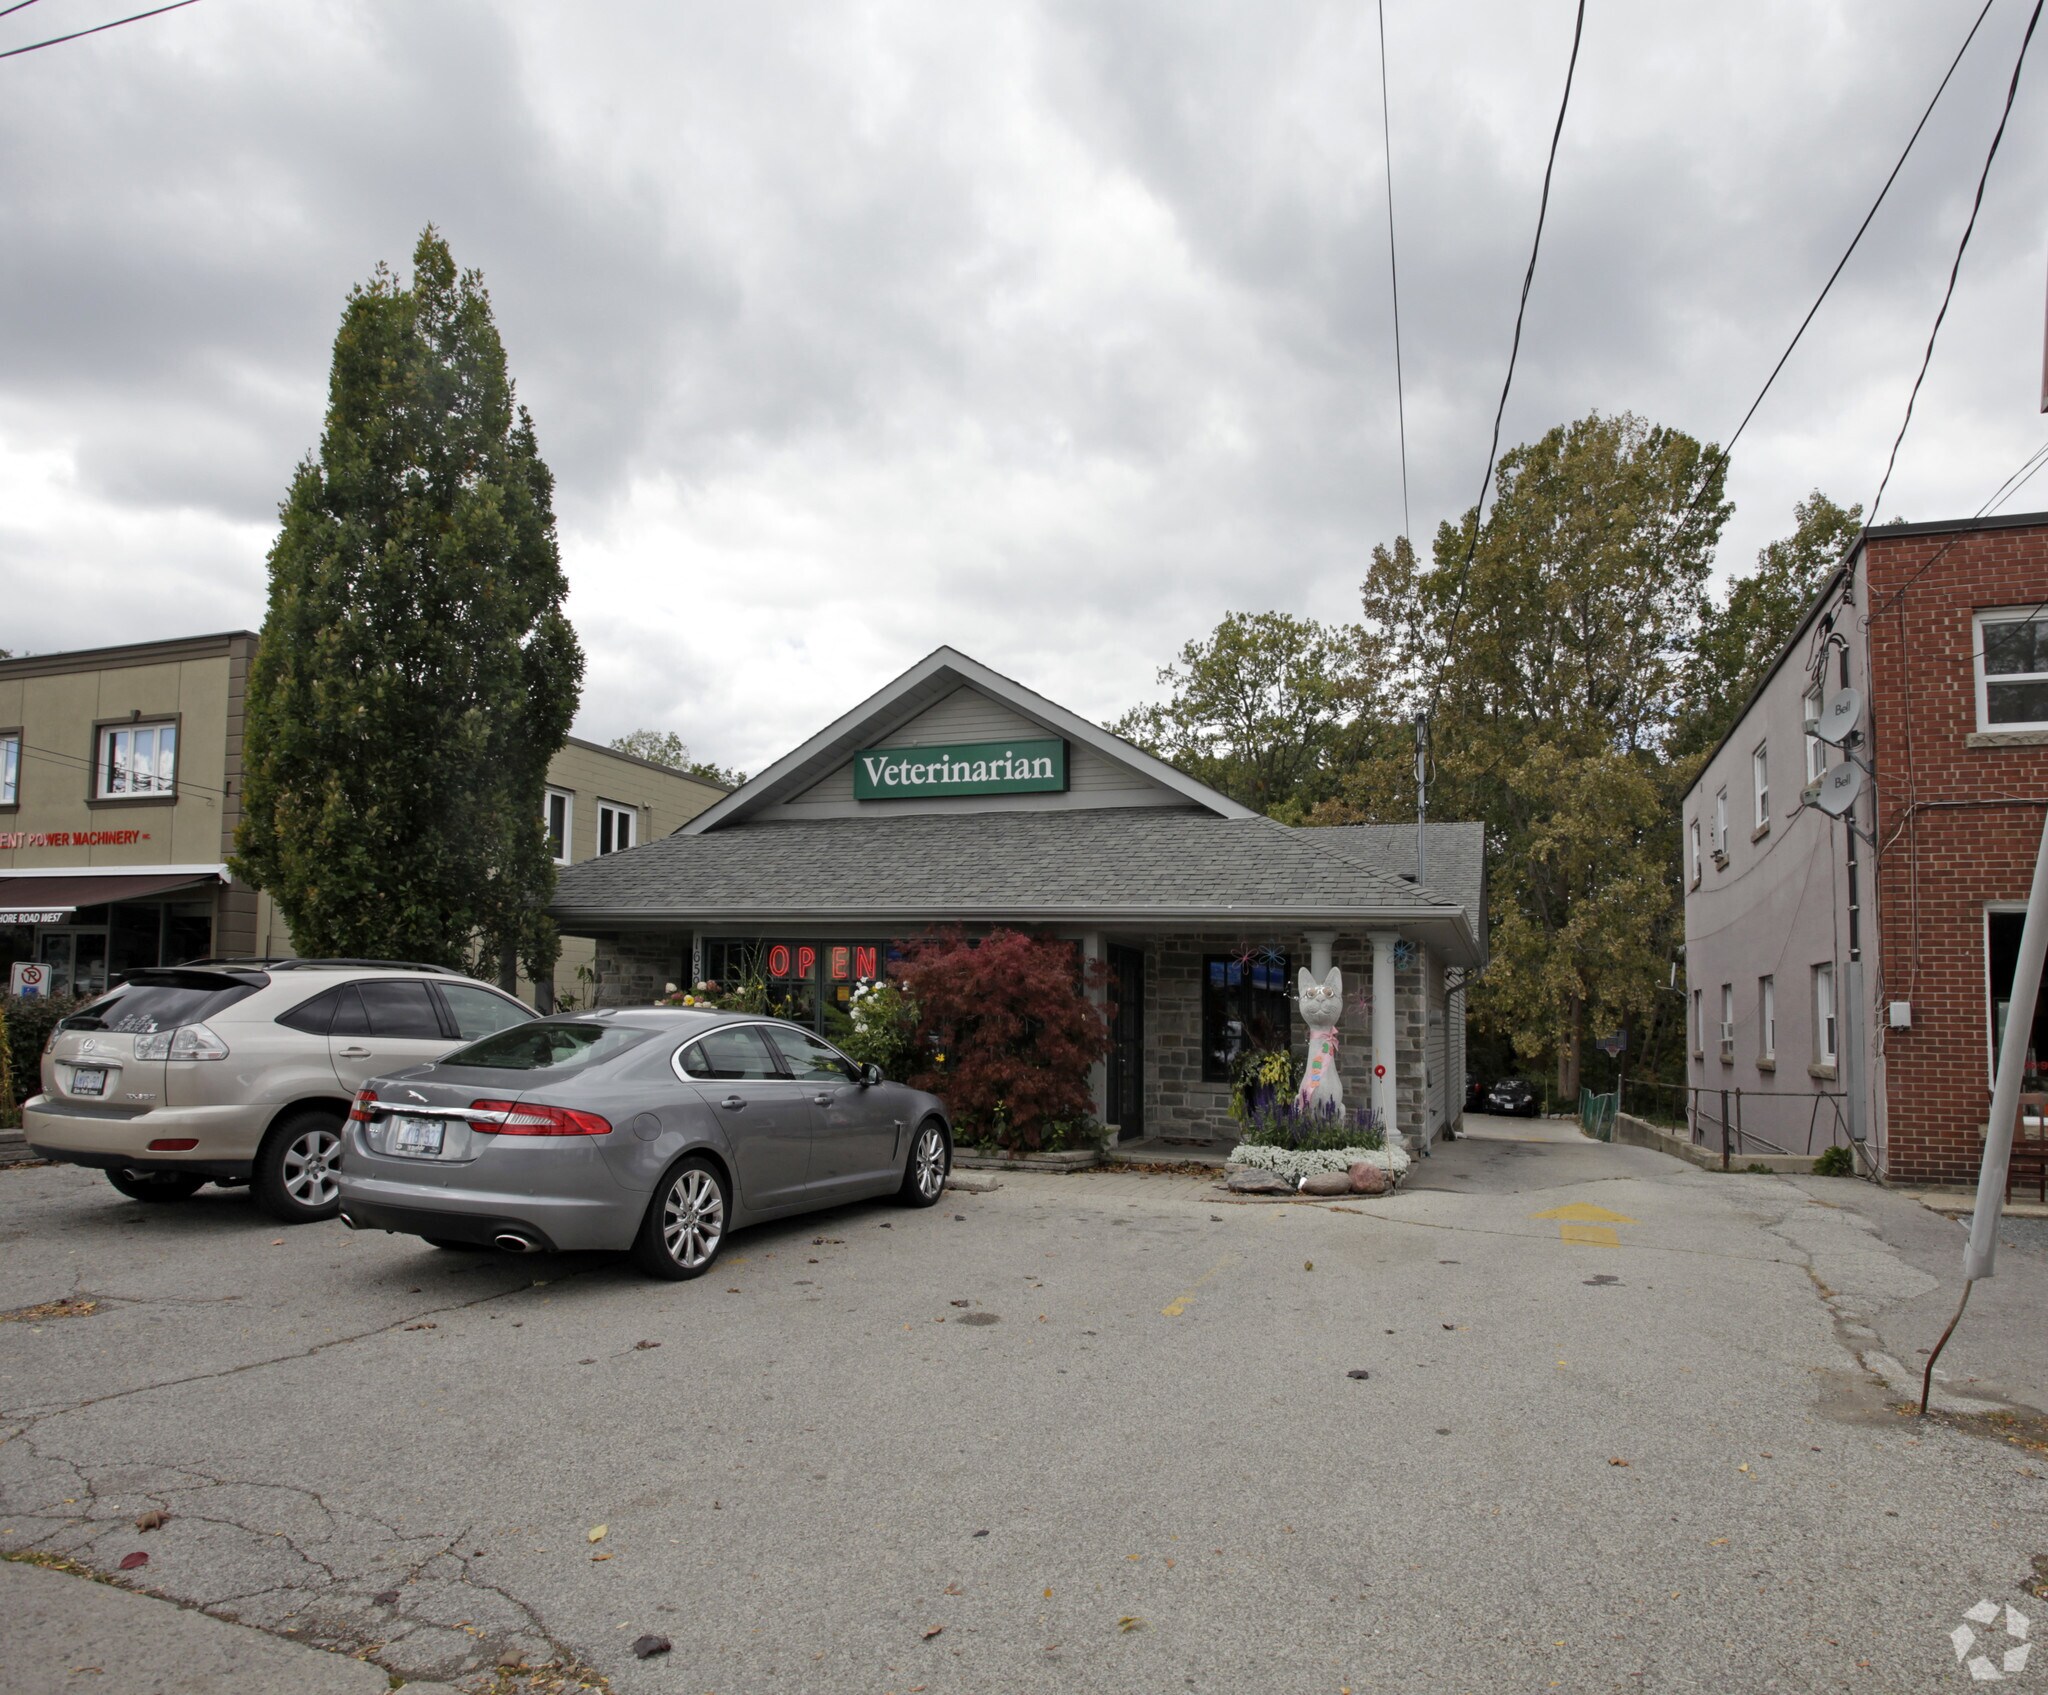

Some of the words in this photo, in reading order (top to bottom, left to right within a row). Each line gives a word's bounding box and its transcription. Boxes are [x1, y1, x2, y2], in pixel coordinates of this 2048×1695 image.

[1835, 701, 1851, 716] Bell
[862, 750, 1054, 787] Veterinarian
[1834, 774, 1851, 789] Bell
[28, 832, 70, 847] POWER
[71, 830, 140, 846] MACHINERY
[18, 913, 40, 923] ROAD
[40, 912, 63, 923] WEST
[769, 945, 876, 979] OPEN
